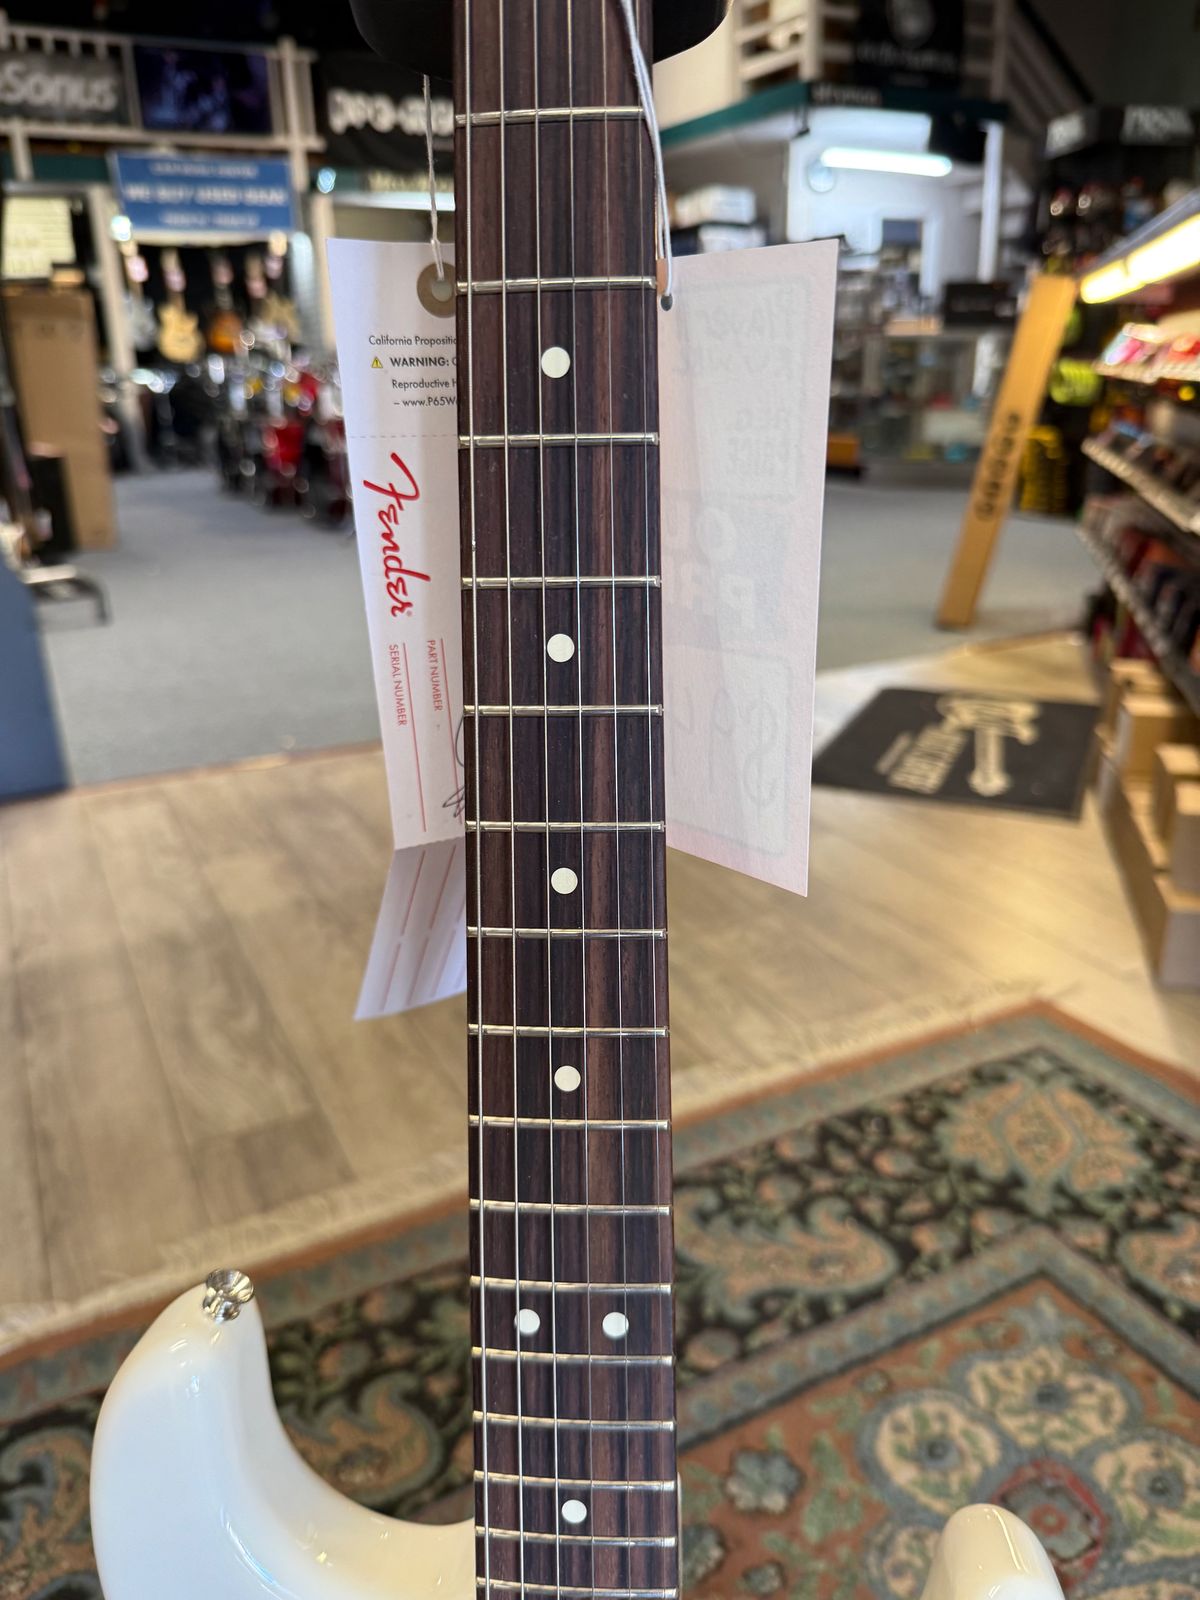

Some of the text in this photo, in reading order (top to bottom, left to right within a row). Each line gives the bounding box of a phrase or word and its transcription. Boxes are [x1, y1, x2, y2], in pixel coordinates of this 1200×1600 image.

[368, 335, 412, 345] California
[389, 356, 450, 367] WARNING:
[391, 379, 450, 391] Reproductive
[402, 396, 458, 407] www.P65W
[363, 452, 432, 618] Fender
[427, 639, 444, 712] PART NUMBER
[389, 643, 408, 727] SERIAL NUMBER
